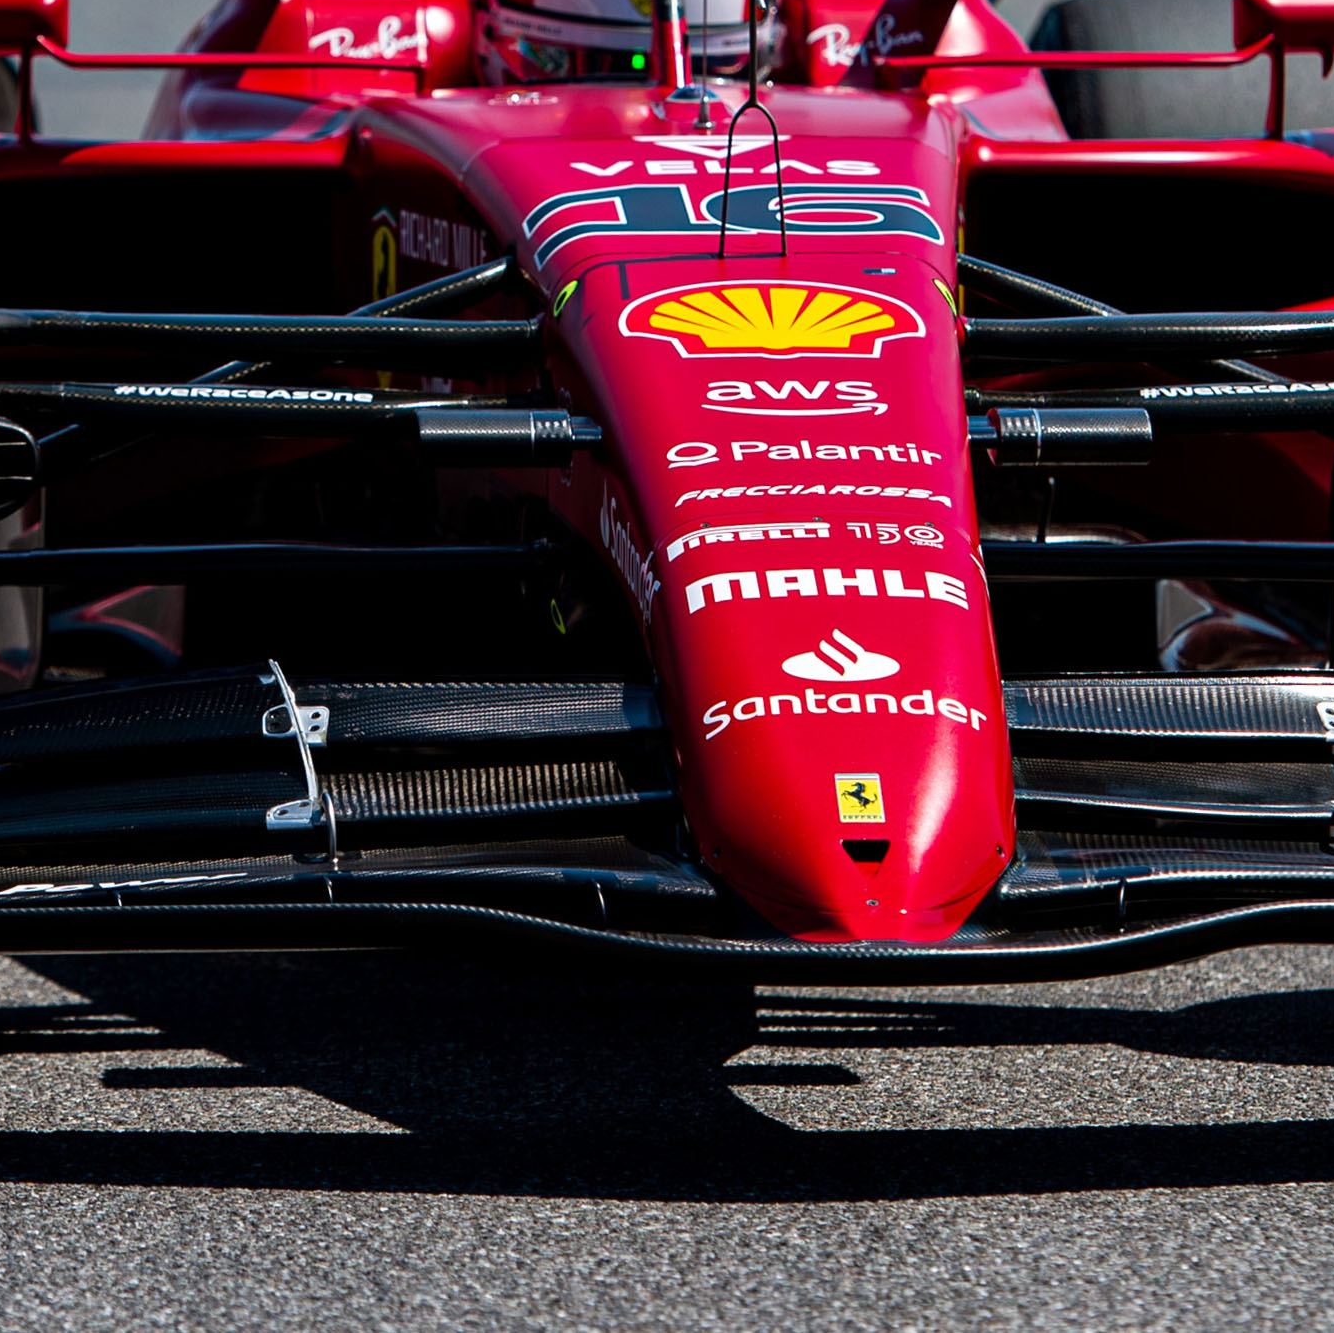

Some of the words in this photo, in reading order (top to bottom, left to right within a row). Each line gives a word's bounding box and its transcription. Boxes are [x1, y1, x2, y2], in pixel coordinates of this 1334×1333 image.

[569, 159, 882, 177] VELAS
[521, 182, 946, 272] 16
[113, 383, 375, 404] #WeRaceAsOne
[705, 379, 879, 402] aws
[730, 439, 943, 466] Palantir
[673, 484, 953, 509] FRECCIAROSSA
[666, 521, 832, 563] PIRELLI
[684, 567, 970, 615] MAHLE
[702, 687, 988, 741] Santander
